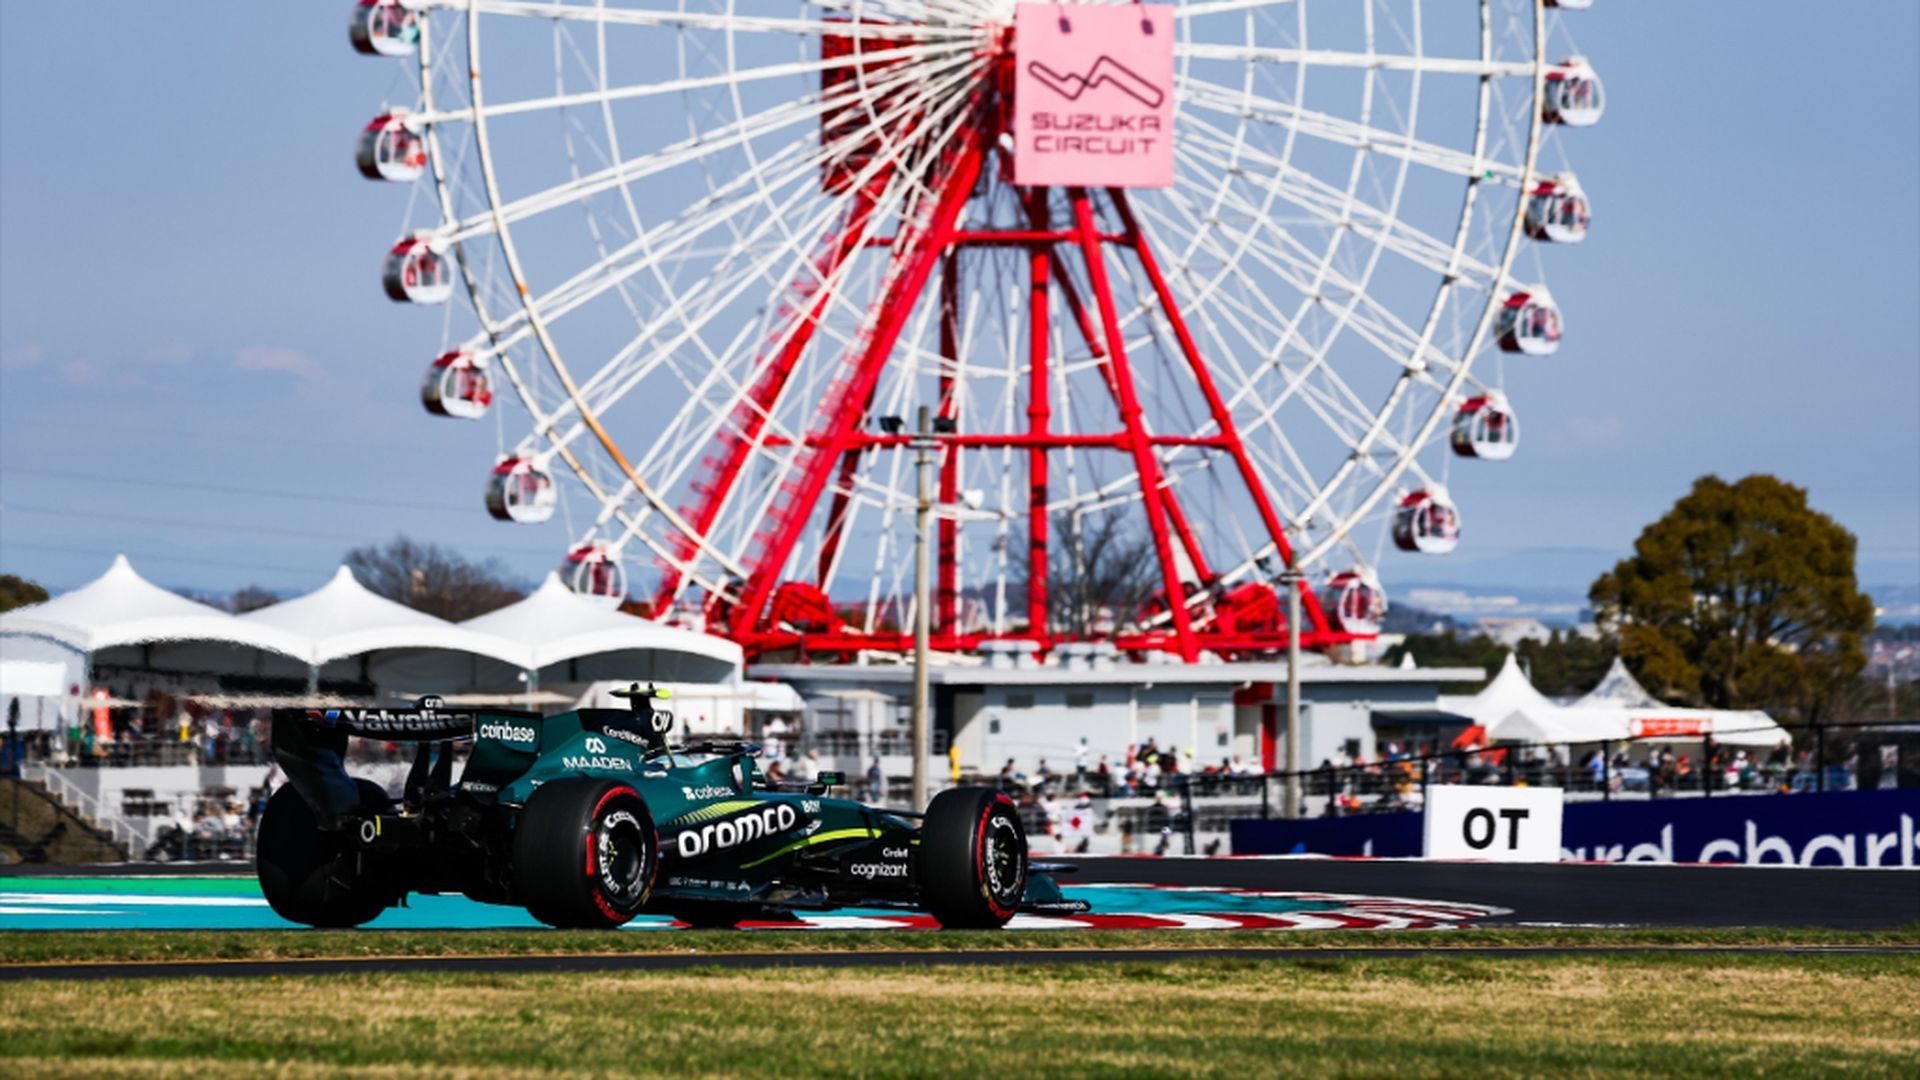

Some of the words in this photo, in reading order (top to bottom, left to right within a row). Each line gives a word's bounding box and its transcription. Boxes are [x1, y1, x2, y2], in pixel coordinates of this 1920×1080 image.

[1031, 112, 1161, 132] SUZUKA
[1033, 136, 1155, 154] CIRCUIT
[344, 709, 472, 732] Valvoline
[480, 721, 535, 742] coinbase
[562, 755, 633, 771] MAADEN
[1462, 807, 1530, 850] OT
[850, 861, 908, 880] cognizant
